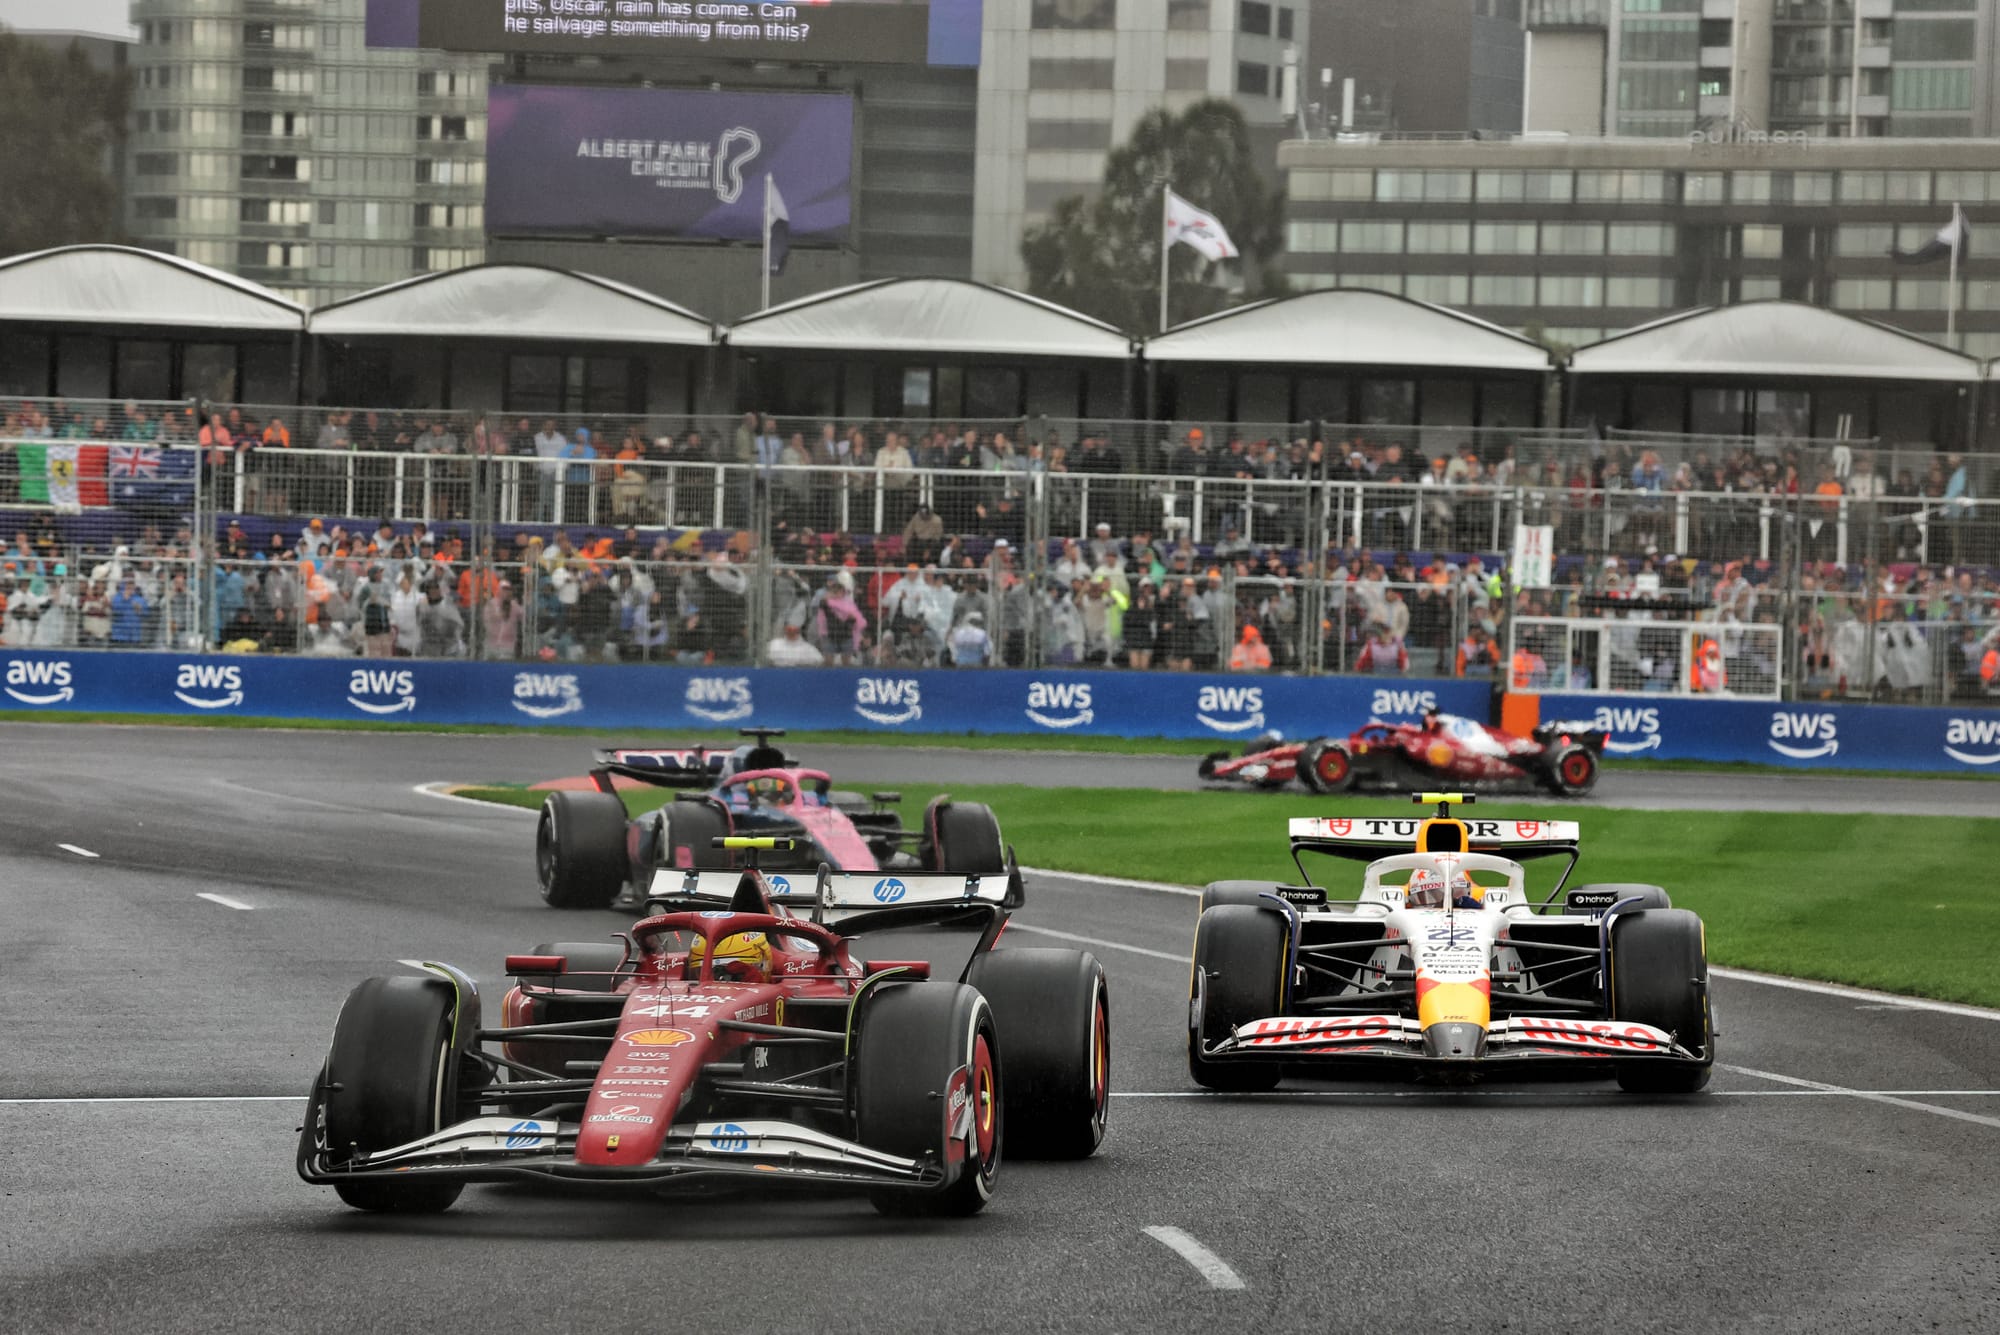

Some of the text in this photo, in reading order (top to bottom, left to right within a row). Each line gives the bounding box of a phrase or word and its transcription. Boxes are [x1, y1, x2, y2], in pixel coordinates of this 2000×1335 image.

[616, 0, 652, 16] rain
[657, 0, 692, 16] has
[698, 2, 755, 19] come.
[760, 3, 797, 19] Can
[504, 15, 810, 41] he salvage something from this?
[577, 138, 712, 161] ALBERT PARK
[631, 161, 712, 177] CIRCUIT
[7, 660, 72, 686] aws
[177, 664, 242, 690] aws
[350, 669, 414, 695] aws
[513, 672, 578, 698] aws
[687, 677, 752, 703] aws
[857, 678, 921, 705] aws
[1028, 682, 1092, 709] aws
[1198, 686, 1263, 713] aws
[1372, 689, 1436, 715] aws
[1594, 707, 1660, 734] aws
[1770, 712, 1836, 739] aws
[1366, 820, 1502, 837] TUR
[876, 878, 904, 902] hp
[1427, 929, 1475, 941] 22
[783, 960, 815, 973] Ray-Ban
[631, 1005, 711, 1018] 44
[1252, 1016, 1389, 1045] HUGO
[1520, 1018, 1657, 1050] HUGO
[613, 1066, 670, 1074] IBM
[510, 1121, 541, 1148] hp
[715, 1124, 748, 1151] hp
